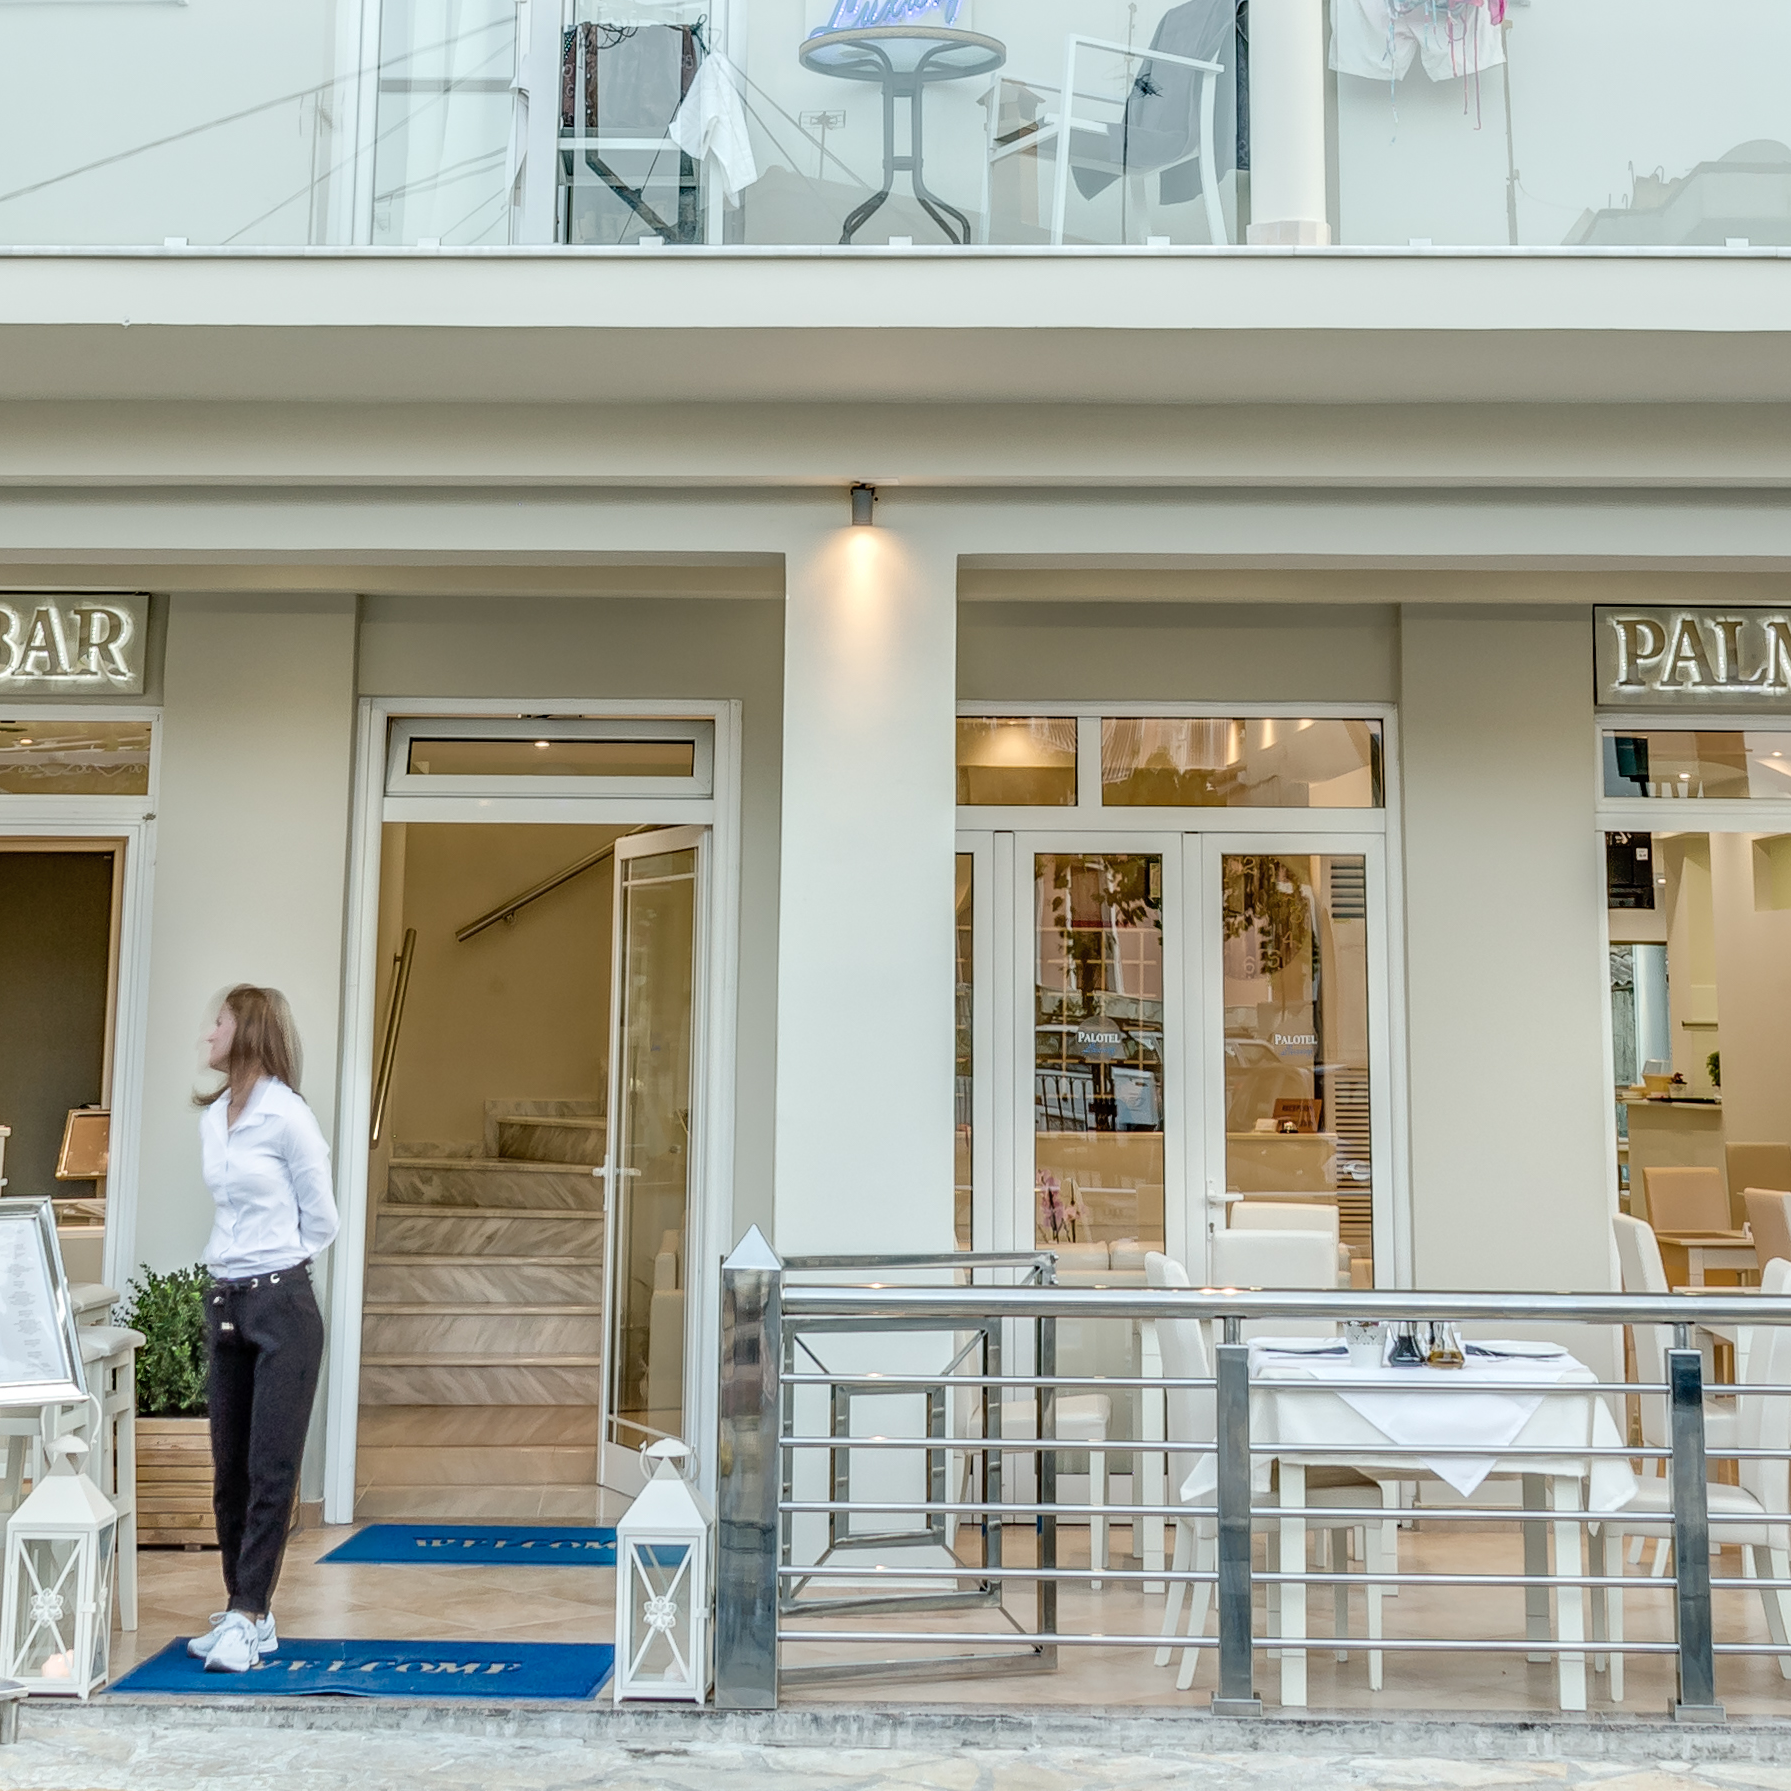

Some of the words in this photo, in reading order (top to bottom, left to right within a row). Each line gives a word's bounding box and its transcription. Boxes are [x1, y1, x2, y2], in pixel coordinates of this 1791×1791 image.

[1077, 1031, 1121, 1043] PALOTEL
[1274, 1033, 1318, 1045] PALOTEL
[414, 1537, 616, 1550] WELCOM
